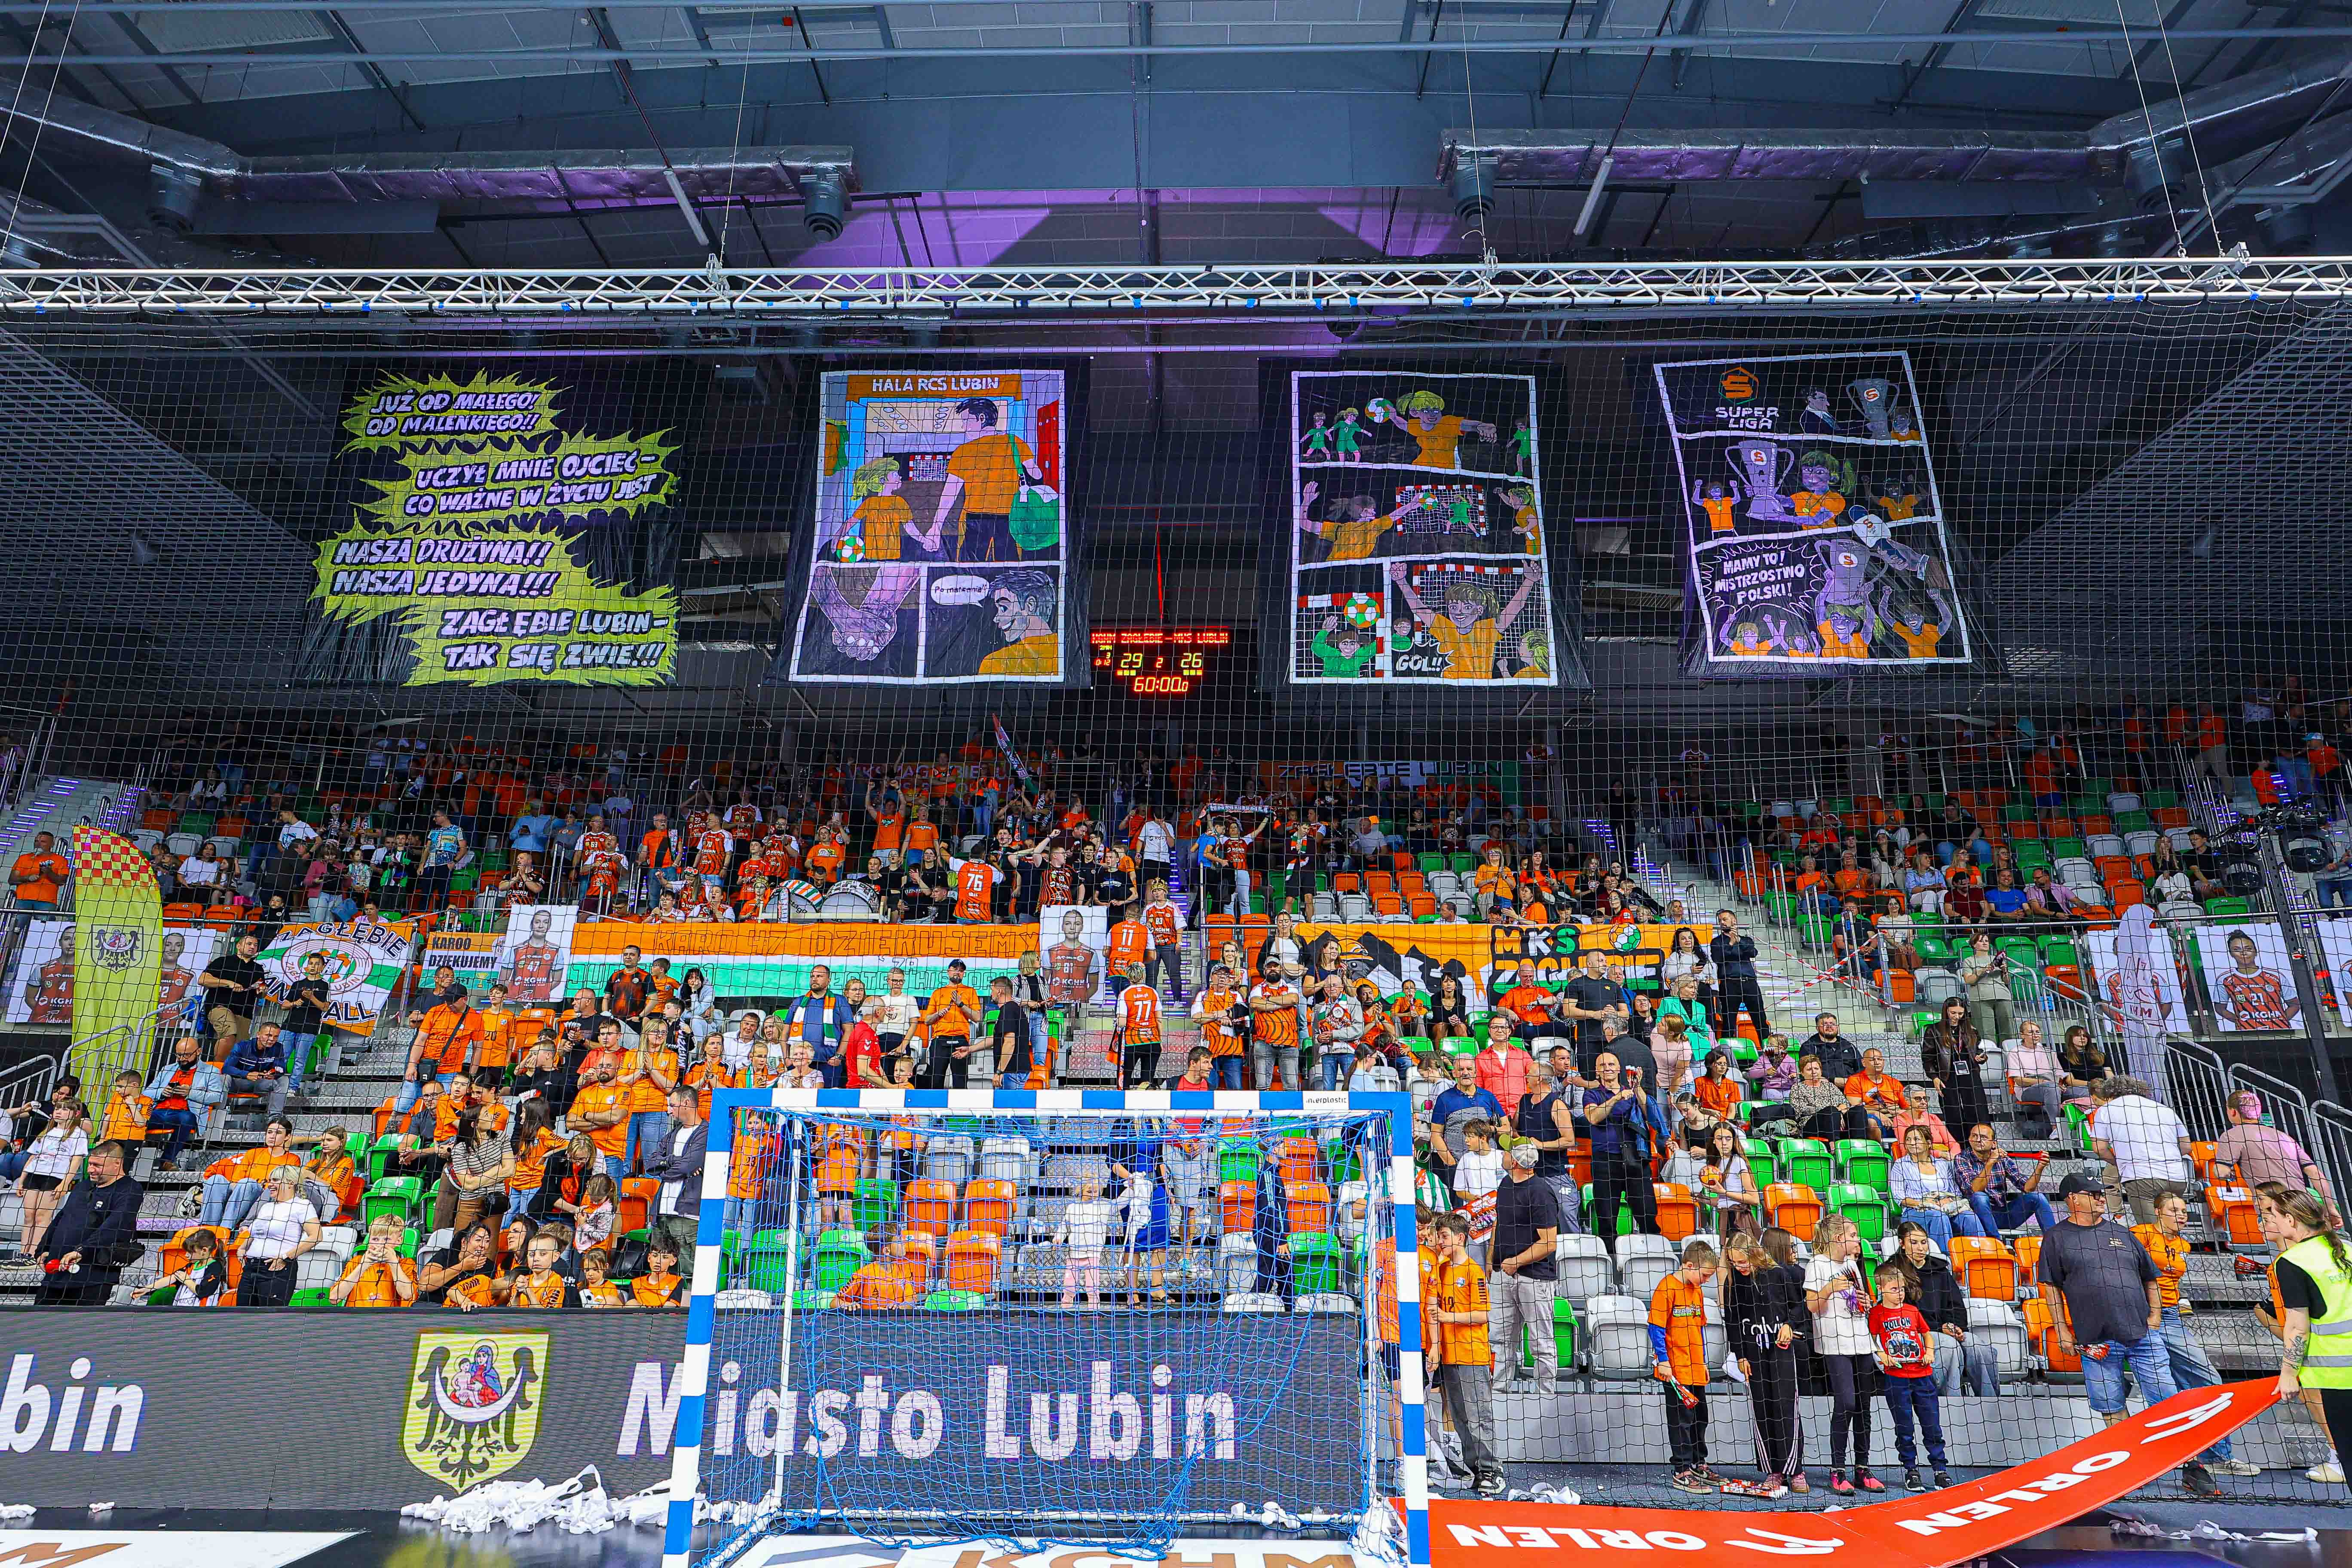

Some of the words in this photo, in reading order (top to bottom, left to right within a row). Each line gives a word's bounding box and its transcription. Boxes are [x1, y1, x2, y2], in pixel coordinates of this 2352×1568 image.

[872, 378, 914, 392] HALA
[918, 377, 947, 391] RCS
[951, 377, 999, 391] LUBIN
[371, 391, 413, 413] JUŻ
[418, 394, 450, 410] OD
[453, 393, 542, 410] MAŁEGO!
[1715, 407, 1779, 419] SUPER
[364, 415, 396, 435] OD
[1729, 418, 1773, 429] LIGA
[416, 466, 487, 489] UCZYŁ
[496, 458, 554, 482] MNIE
[405, 493, 431, 514] CO
[439, 487, 514, 512] WAŻNE
[519, 489, 543, 508] W
[547, 478, 609, 505] ŻYCIU
[614, 473, 657, 500] JEST
[335, 540, 411, 564] NASZA
[416, 537, 554, 566] DRUŻYNA!!
[1723, 555, 1760, 574] MAMY
[333, 571, 414, 594] NASZA
[418, 572, 560, 596] JEDYNA!!!
[1715, 564, 1805, 592] MISTRZOSTWO
[1736, 582, 1792, 605] POLSKI!
[444, 645, 498, 668] TAK
[509, 644, 555, 671] SIĘ
[563, 644, 666, 668] ZWIE!!!
[1121, 653, 1143, 668] 29
[1156, 658, 1163, 668] 2
[1181, 653, 1202, 668] 26
[1396, 655, 1443, 672] GOL!!
[966, 873, 984, 892] 76
[279, 923, 408, 959] ZAGŁĘBIE
[432, 937, 472, 950] KAROO
[1121, 929, 1134, 946] 11
[1495, 928, 1576, 956] MKS
[527, 961, 540, 972] 47
[58, 981, 66, 992] 4
[2251, 993, 2264, 1006] 21
[1134, 1000, 1152, 1022] 77
[2252, 1010, 2282, 1019] KGHM
[1559, 1187, 1572, 1195] 4F
[2165, 1245, 2176, 1262] 99
[377, 1269, 385, 1287] 7
[1443, 1296, 1455, 1313] 12
[1883, 1319, 1899, 1330] ROLL
[984, 1361, 1238, 1461] Lubin
[1895, 1451, 2131, 1536] ORLEN
[1446, 1524, 1707, 1550] ORLEN
